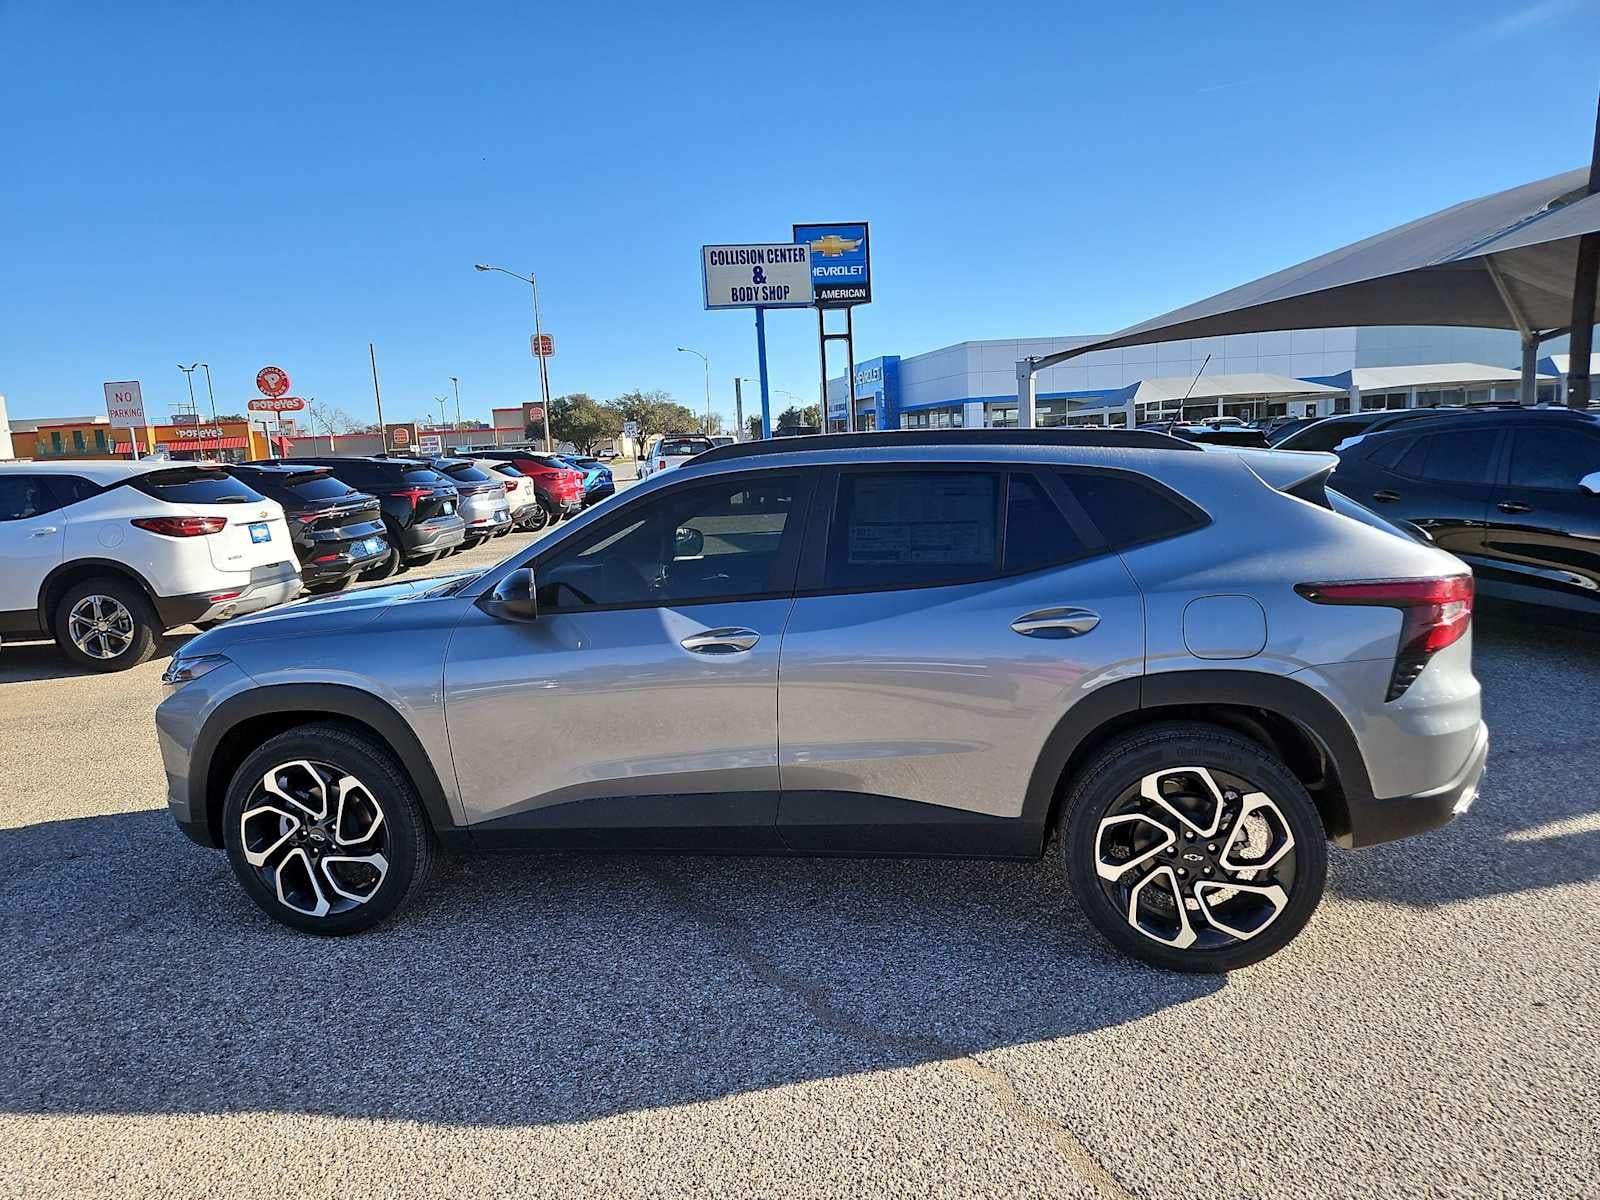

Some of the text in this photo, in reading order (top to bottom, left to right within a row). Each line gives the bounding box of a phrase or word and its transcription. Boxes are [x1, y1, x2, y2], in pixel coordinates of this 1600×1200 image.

[710, 247, 806, 266] COLLISION CENTER
[752, 265, 767, 285] &
[812, 265, 864, 277] HEVROLET
[731, 285, 790, 302] BODY SHOP
[821, 289, 866, 299] AMERICAN
[115, 392, 132, 402] NO
[111, 408, 142, 418] PARKING
